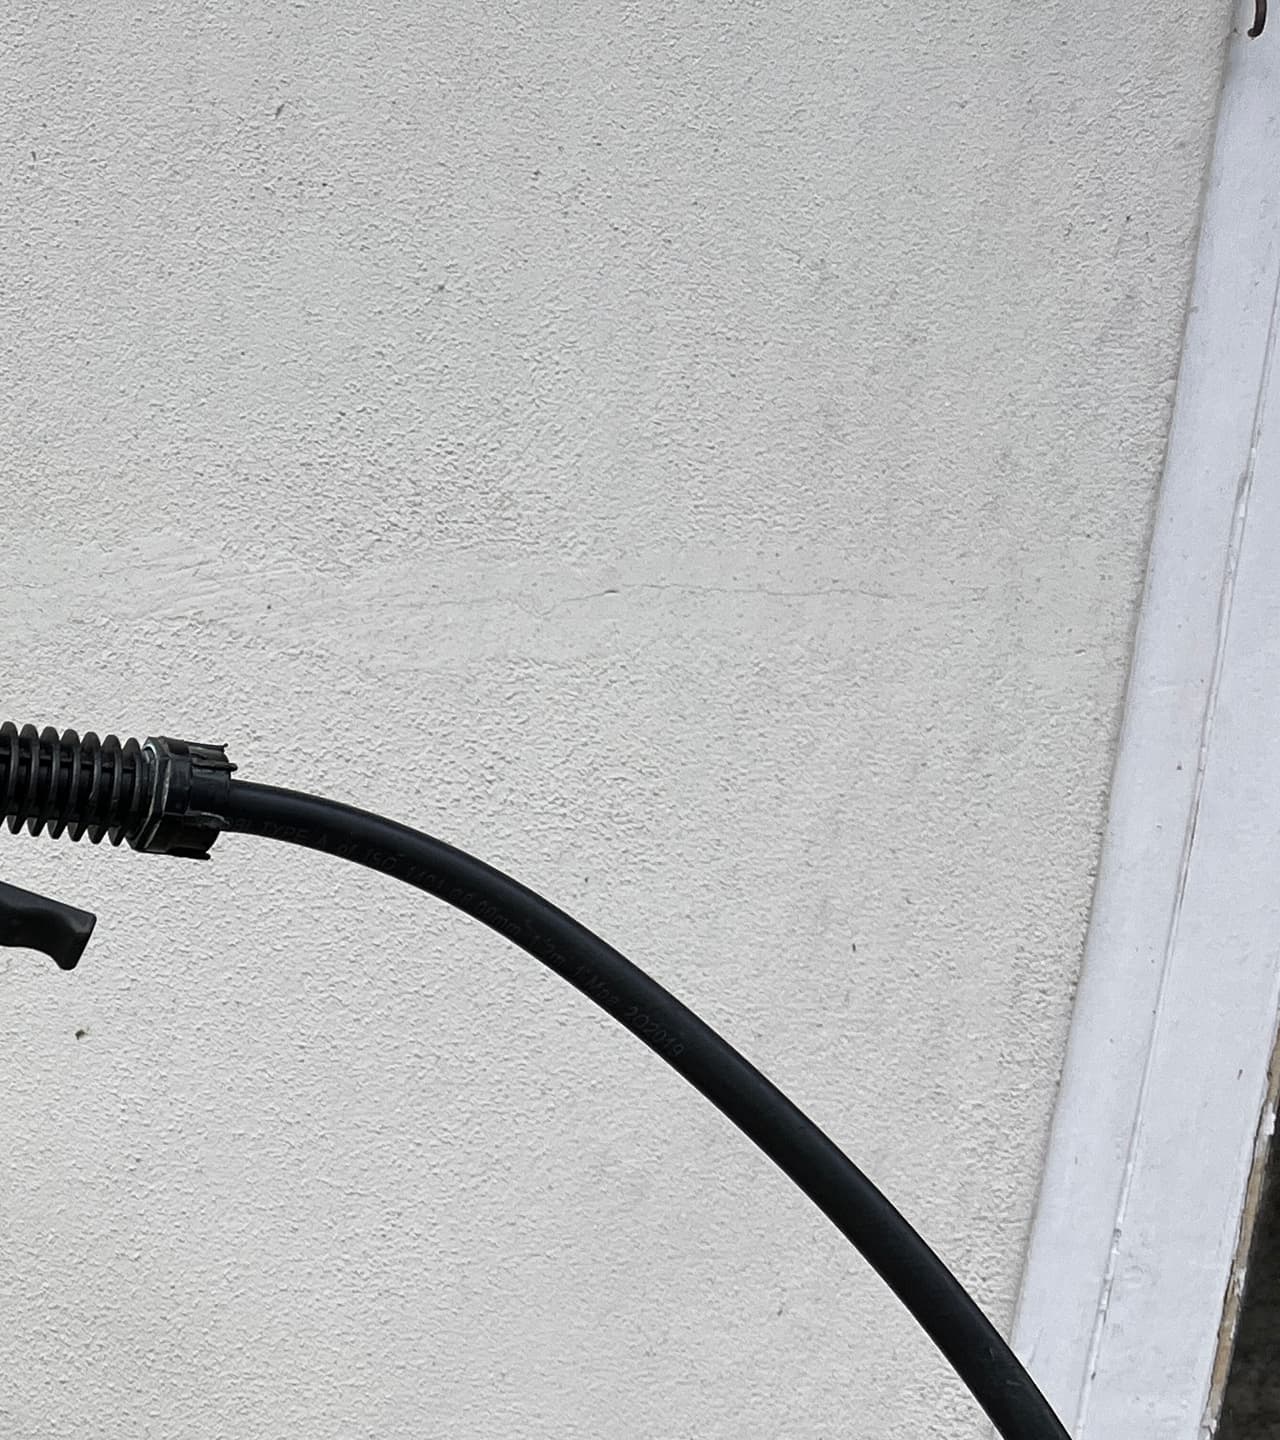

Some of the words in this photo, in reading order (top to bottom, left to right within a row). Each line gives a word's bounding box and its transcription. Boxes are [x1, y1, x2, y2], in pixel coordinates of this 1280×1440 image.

[262, 820, 310, 841] TYPE
[365, 849, 397, 871] ISO
[406, 864, 448, 892] 1401
